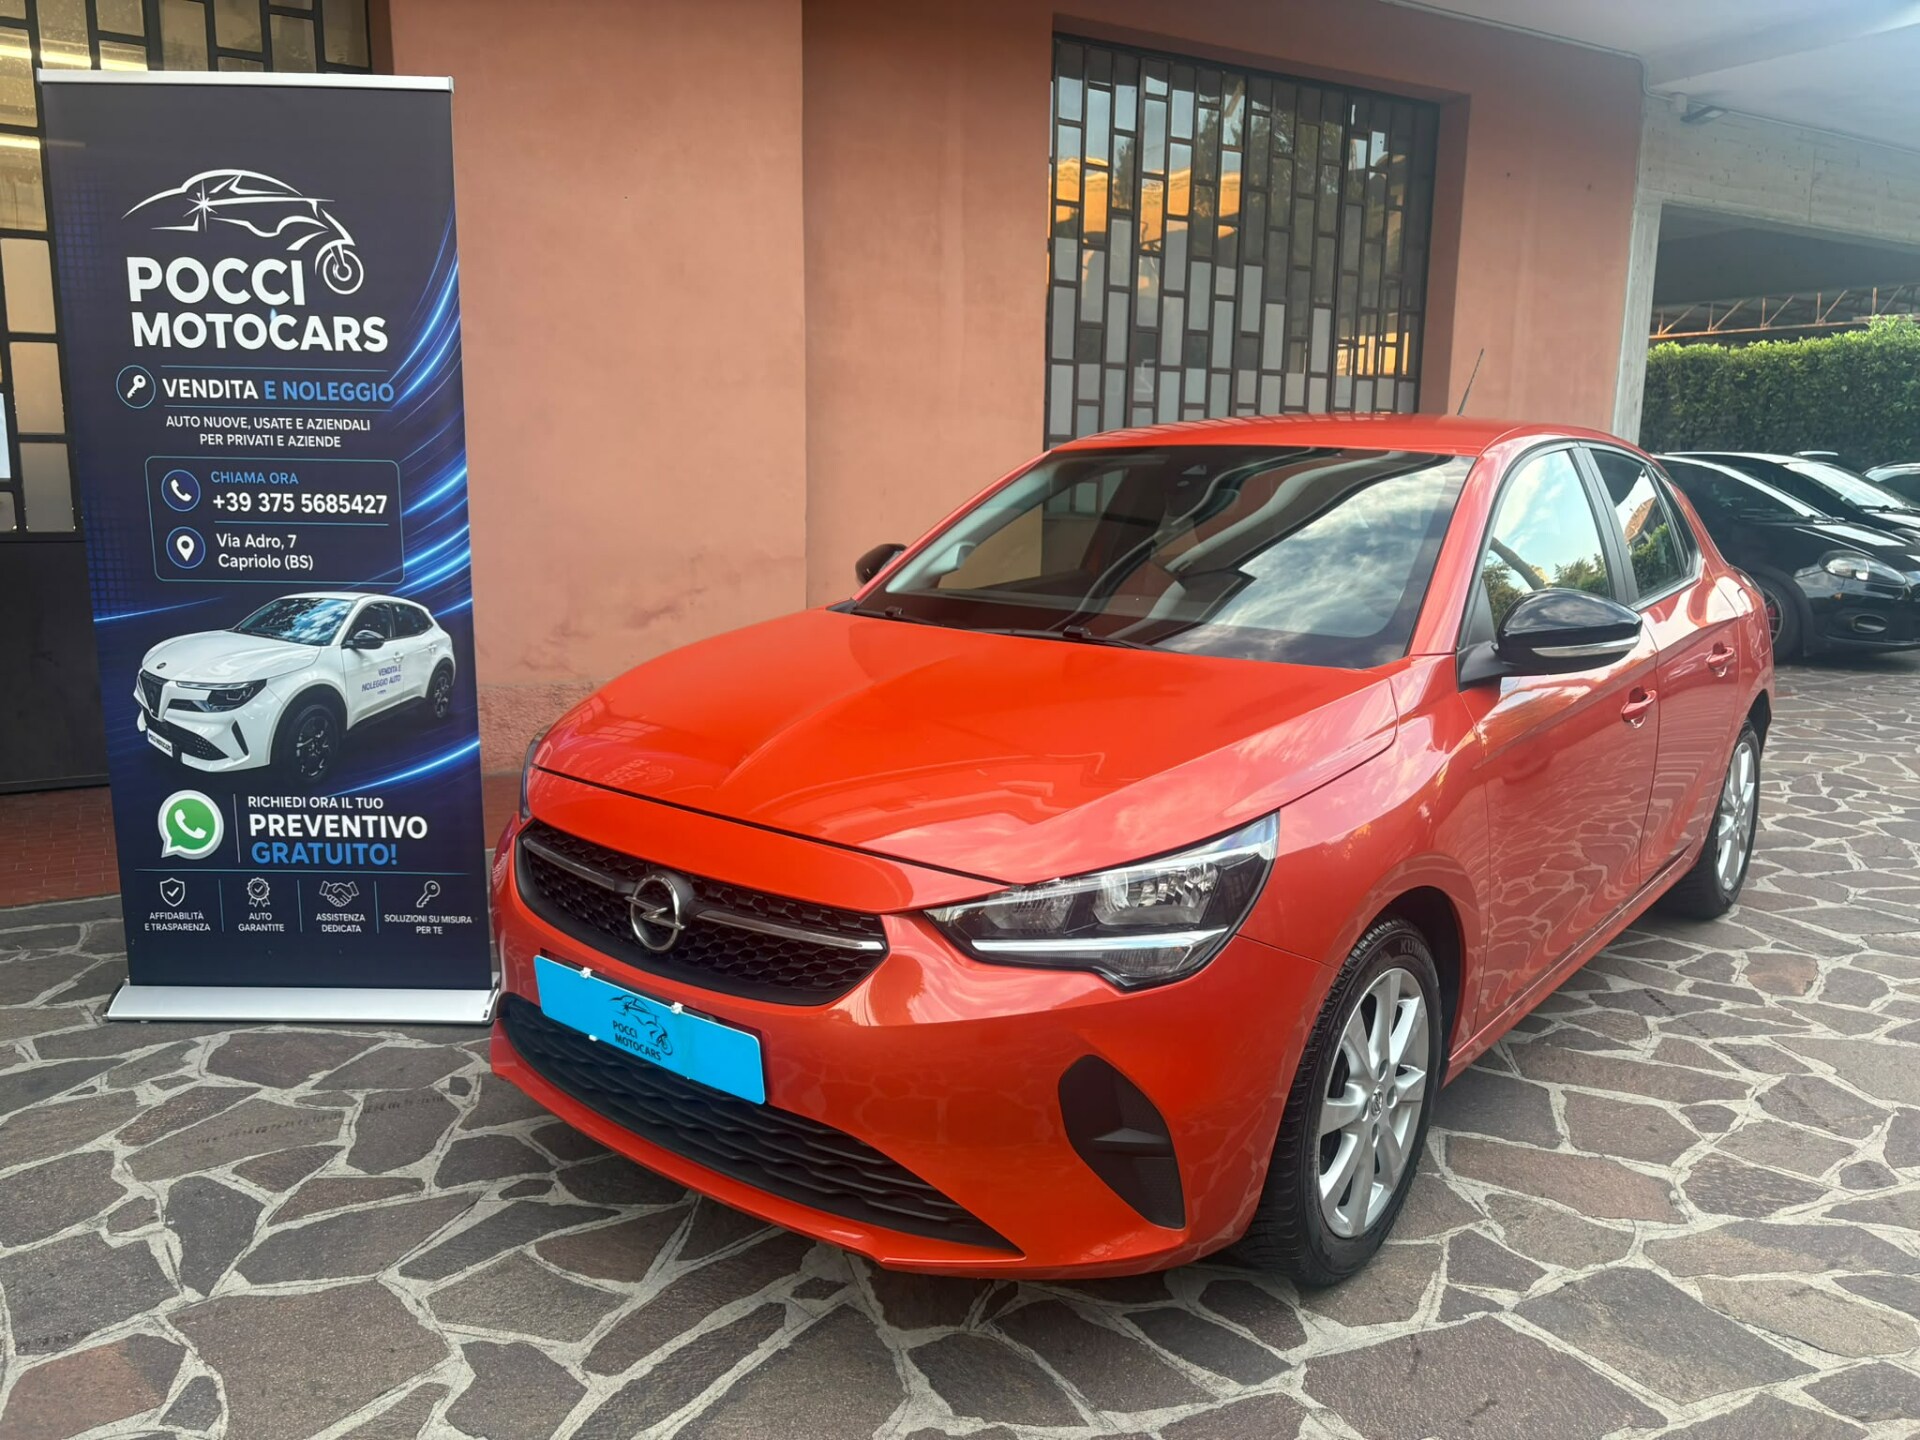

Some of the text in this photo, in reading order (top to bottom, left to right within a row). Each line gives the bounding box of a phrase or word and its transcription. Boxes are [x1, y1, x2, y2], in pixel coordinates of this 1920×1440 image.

[126, 256, 305, 306] POCCI
[131, 311, 388, 353] MOTOCARS
[162, 378, 394, 402] VENDITA E NOLEGGIO
[166, 416, 371, 431] AUTO NUOVE, USATE E AZIENDALI
[200, 434, 341, 448] PER PRIVATI E AZIENDE
[210, 471, 299, 485] CHIAMA ORA
[213, 492, 387, 514] +39 375 5685427
[216, 533, 297, 550] Via Adro, 7
[218, 554, 314, 571] Capriolo (BS)
[361, 678, 388, 692] NOLEGGIO
[247, 796, 384, 809] RICHIEDI ORA IL TUO
[249, 814, 428, 840] PREVENTIVO
[251, 842, 398, 866] GRATUITO!
[149, 911, 204, 920] AFFIDABILITÀ
[249, 912, 272, 921] AUTO
[315, 913, 366, 922] ASSISTENZA
[384, 914, 472, 924] SOLUZIONI SU MISURA
[144, 923, 211, 931] E TRASPARENZA
[238, 923, 285, 932] GARANTITE
[321, 924, 362, 933] DEDICATA
[416, 926, 443, 934] PER TE
[612, 1020, 638, 1039] POCCI
[615, 1033, 662, 1061] MOTOCARS
